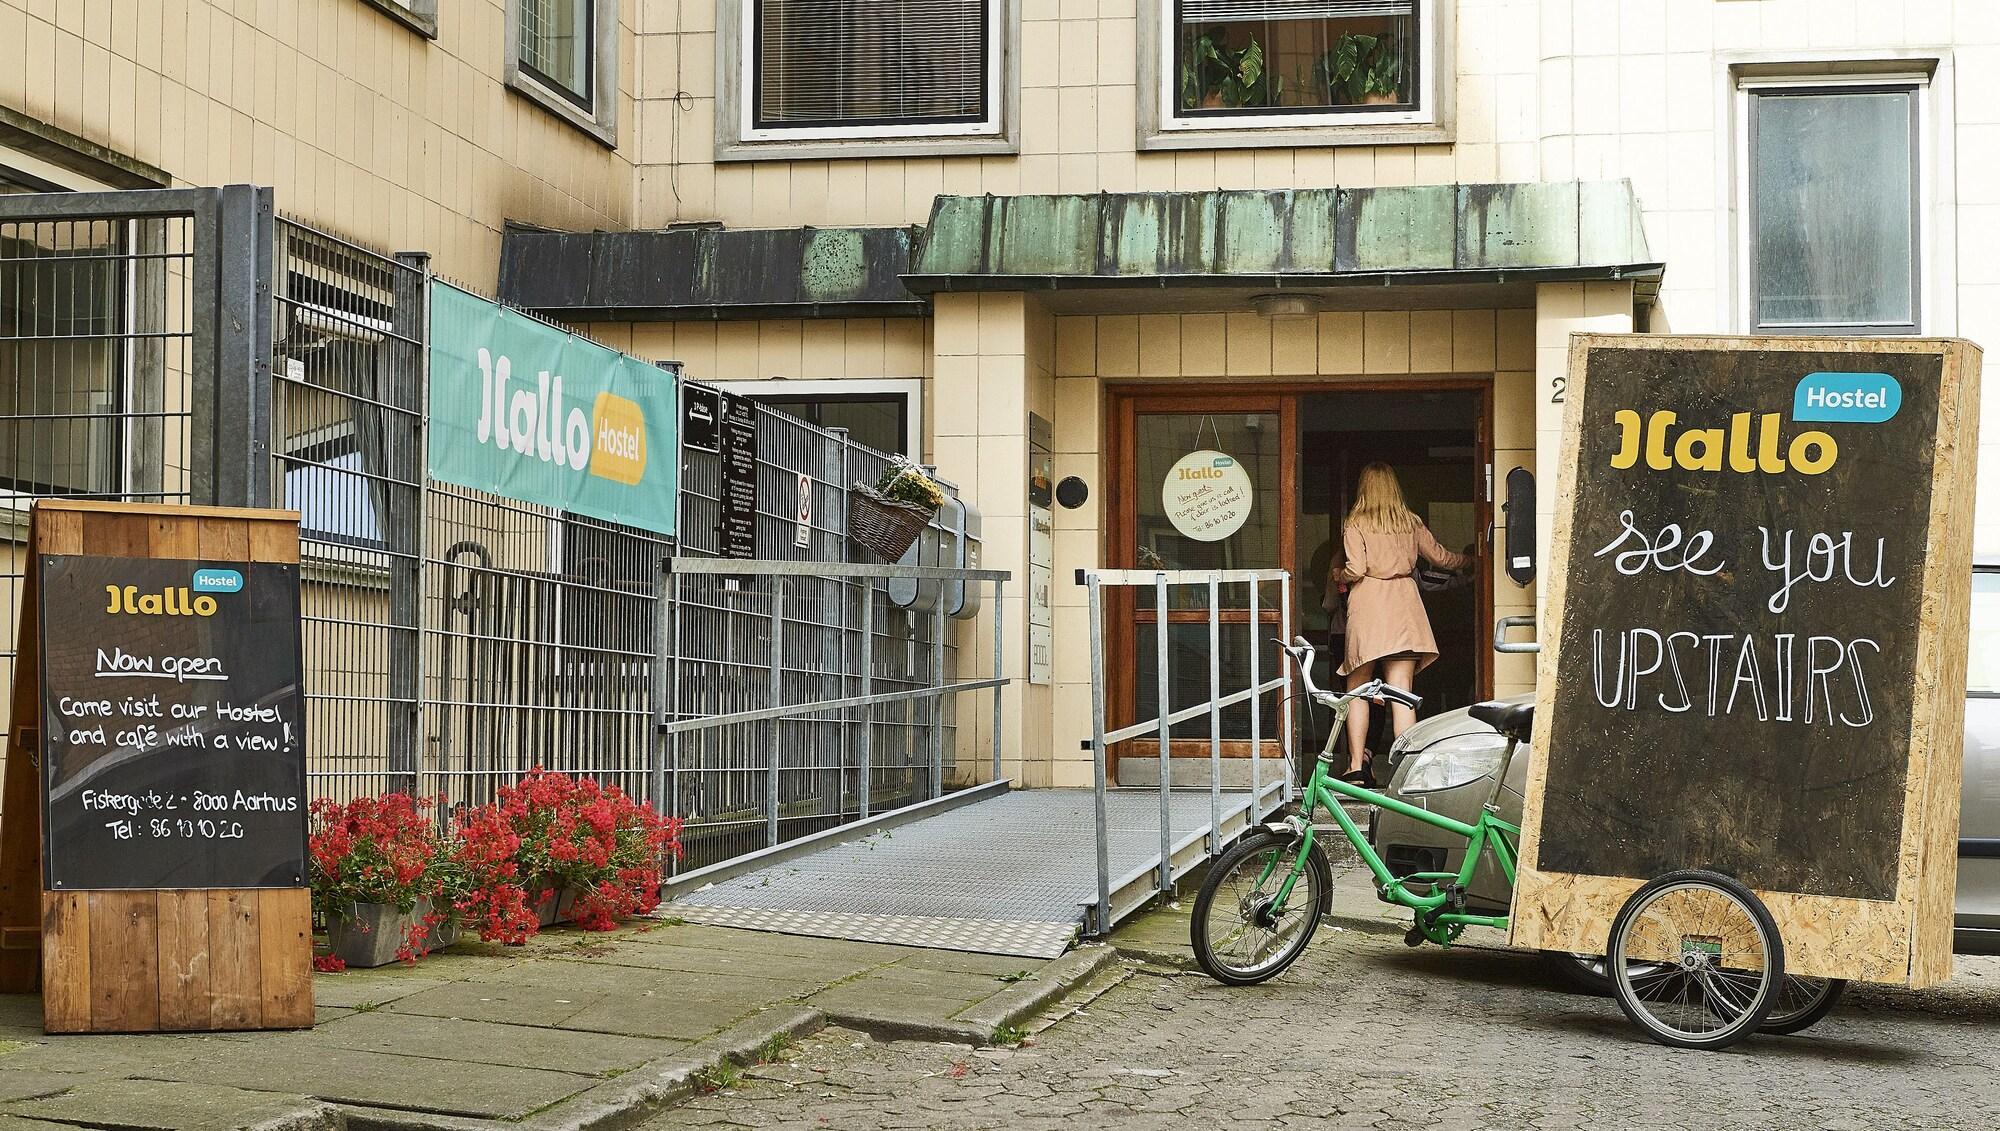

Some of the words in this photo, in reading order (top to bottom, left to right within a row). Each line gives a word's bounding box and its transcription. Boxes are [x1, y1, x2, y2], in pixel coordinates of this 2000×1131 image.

[1551, 376, 1566, 403] 2
[1806, 385, 1887, 409] Hostel
[721, 400, 728, 420] P
[598, 416, 640, 462] Hostel
[1593, 509, 1725, 577] see
[1758, 523, 1895, 614] you
[199, 575, 237, 587] Hostel
[96, 647, 153, 672] Now
[161, 656, 223, 683] open
[1593, 627, 1881, 728] UPSTAIRS
[59, 696, 113, 718] Come
[118, 694, 163, 718] visit
[170, 703, 207, 719] our
[216, 700, 282, 723] Hostel
[69, 724, 107, 746] and
[115, 724, 158, 752] café
[166, 725, 206, 749] with
[213, 734, 229, 750] a
[193, 790, 228, 811] 8000
[232, 788, 298, 812] Aarhus
[150, 818, 171, 838] 86
[197, 818, 216, 839] 10
